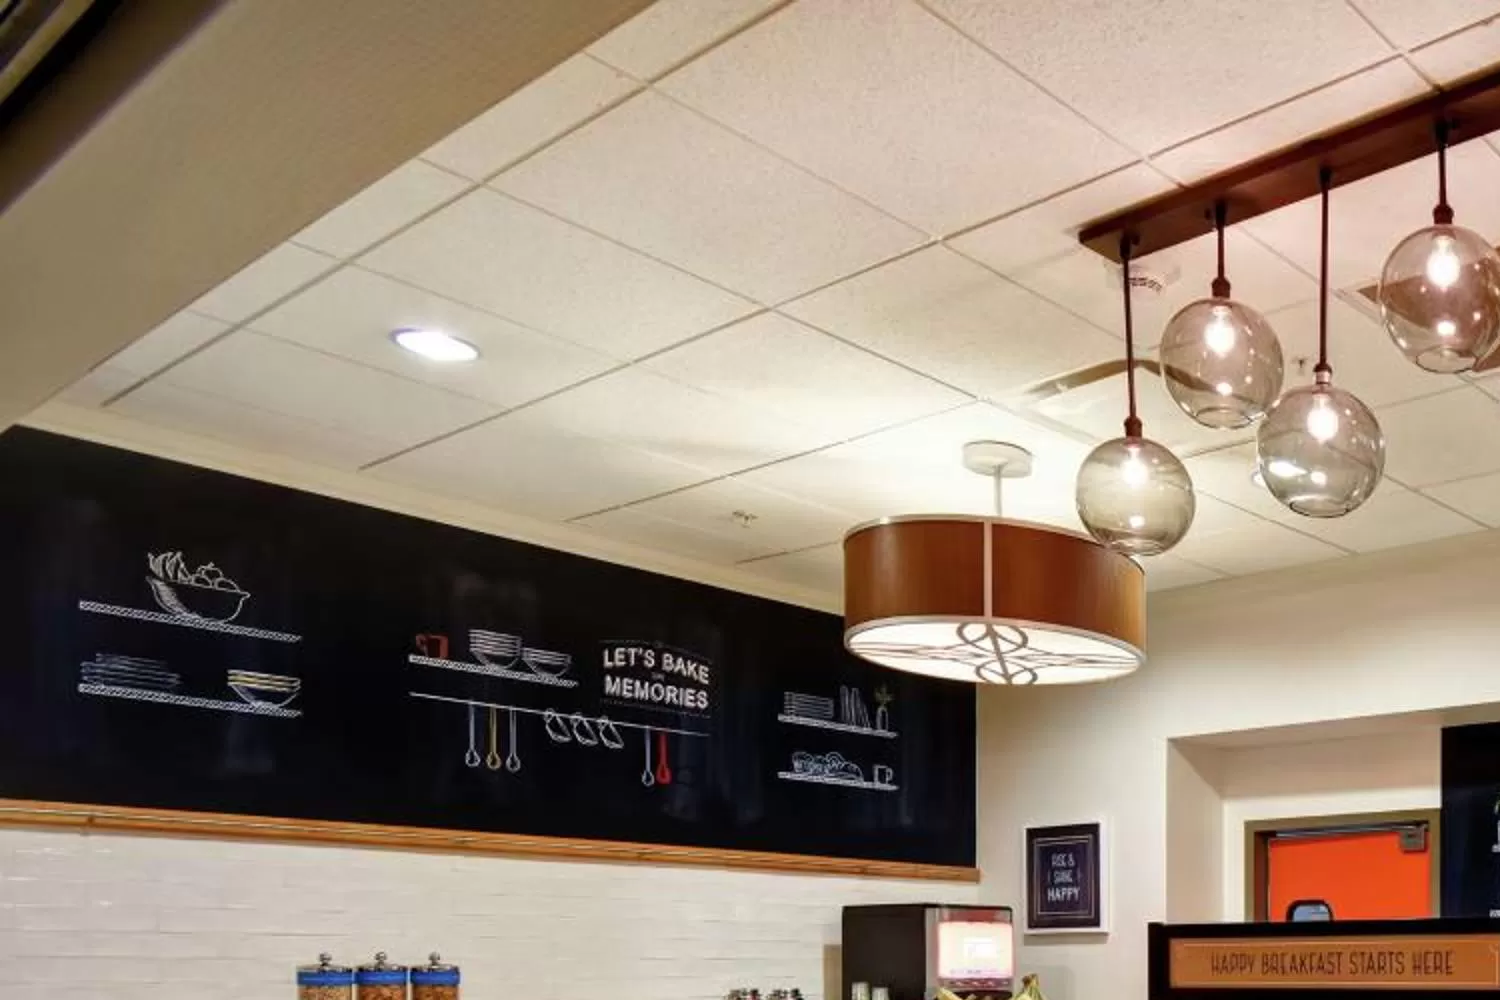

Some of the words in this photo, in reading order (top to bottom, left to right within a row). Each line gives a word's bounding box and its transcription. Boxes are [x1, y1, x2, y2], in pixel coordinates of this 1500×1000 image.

[603, 647, 655, 668] LET'S
[661, 652, 709, 685] BAKE
[604, 674, 709, 709] MEMORIES
[1047, 886, 1081, 903] HAPPY
[1210, 951, 1255, 976] HAPPY
[1261, 951, 1343, 976] BREAKFAST
[1348, 951, 1405, 976] STARTS
[1412, 951, 1454, 976] HERE
